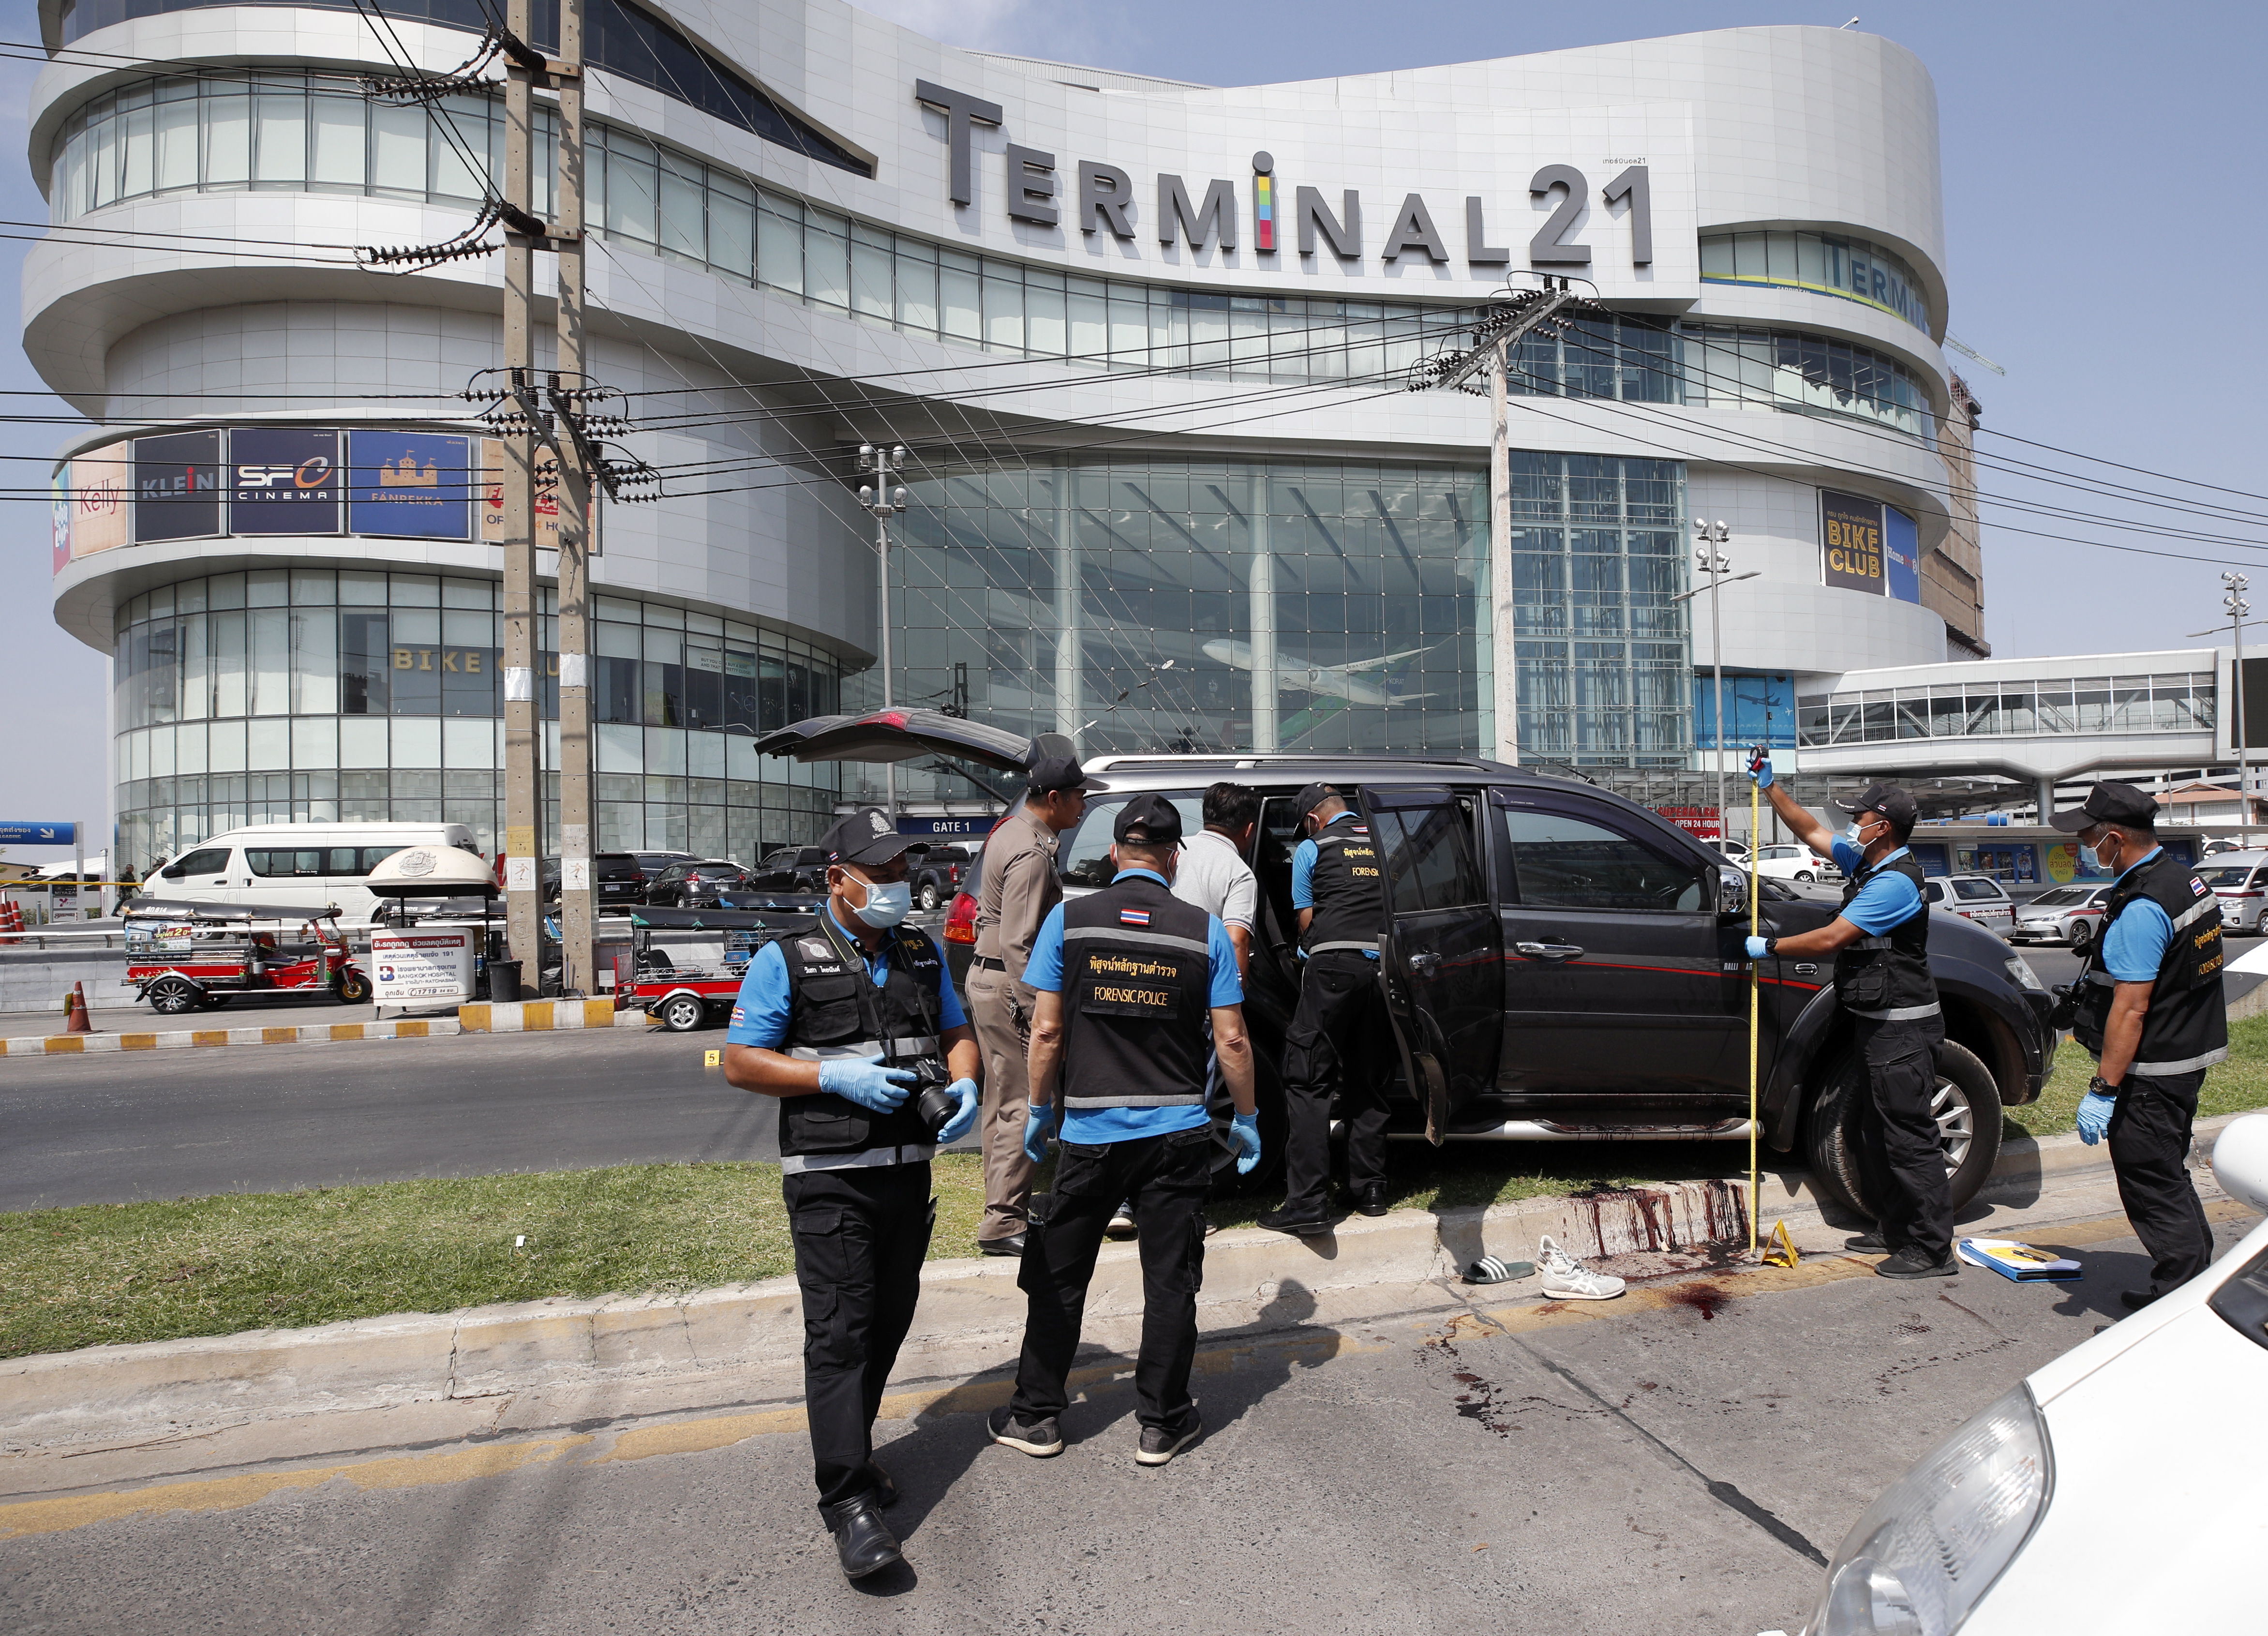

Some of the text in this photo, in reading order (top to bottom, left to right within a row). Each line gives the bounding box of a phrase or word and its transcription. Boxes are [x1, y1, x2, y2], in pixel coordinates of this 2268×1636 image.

[1529, 164, 1653, 265] 21
[81, 479, 119, 515] Kelly
[1828, 519, 1879, 553] BIKE
[1830, 548, 1880, 578] CLUB
[394, 648, 480, 673] BIKE
[933, 822, 970, 832] GATE 1
[1675, 820, 1692, 828] OPEN
[1693, 820, 1701, 828] 24
[174, 928, 181, 936] 2
[397, 964, 456, 972] โรงพยาบาลกรุงเทพ
[1089, 955, 1177, 977] พิสูจน์หลักฐานตำรวจ
[1094, 986, 1168, 1006] FORENSIC POLICE
[709, 1053, 715, 1062] 5
